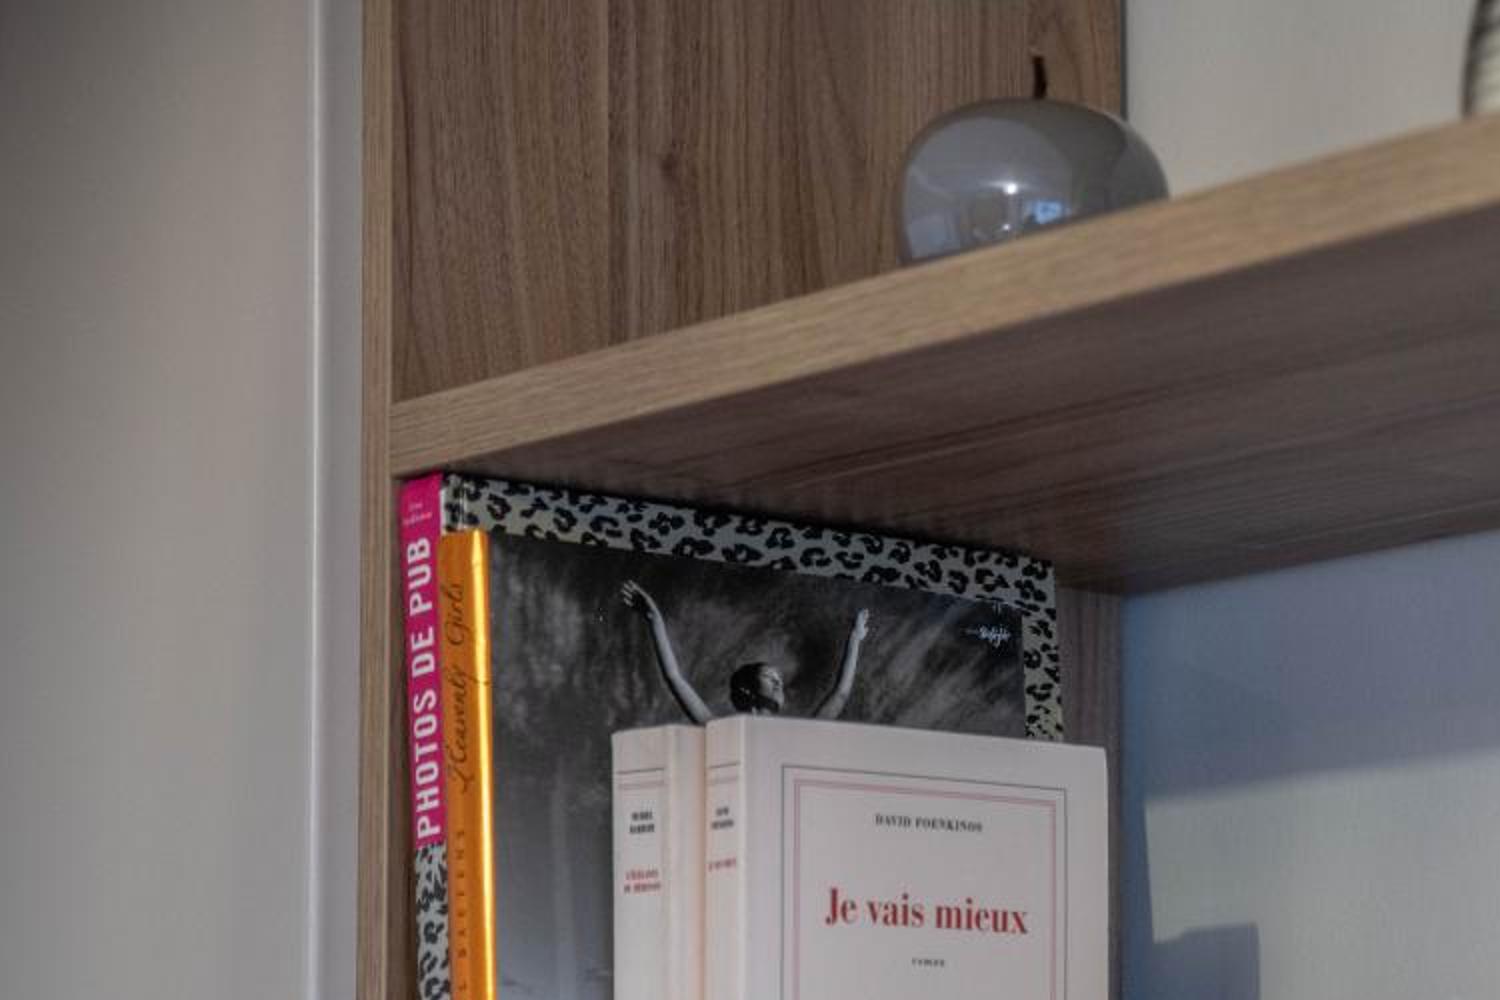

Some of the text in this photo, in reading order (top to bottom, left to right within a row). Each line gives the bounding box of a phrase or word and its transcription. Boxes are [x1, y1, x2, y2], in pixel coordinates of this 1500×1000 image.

[406, 536, 433, 617] PUB
[410, 626, 435, 678] DE
[413, 687, 442, 839] PHOTOS
[875, 813, 983, 833] DAVID FOENKINOS
[825, 887, 1028, 935] Je vais mieux
